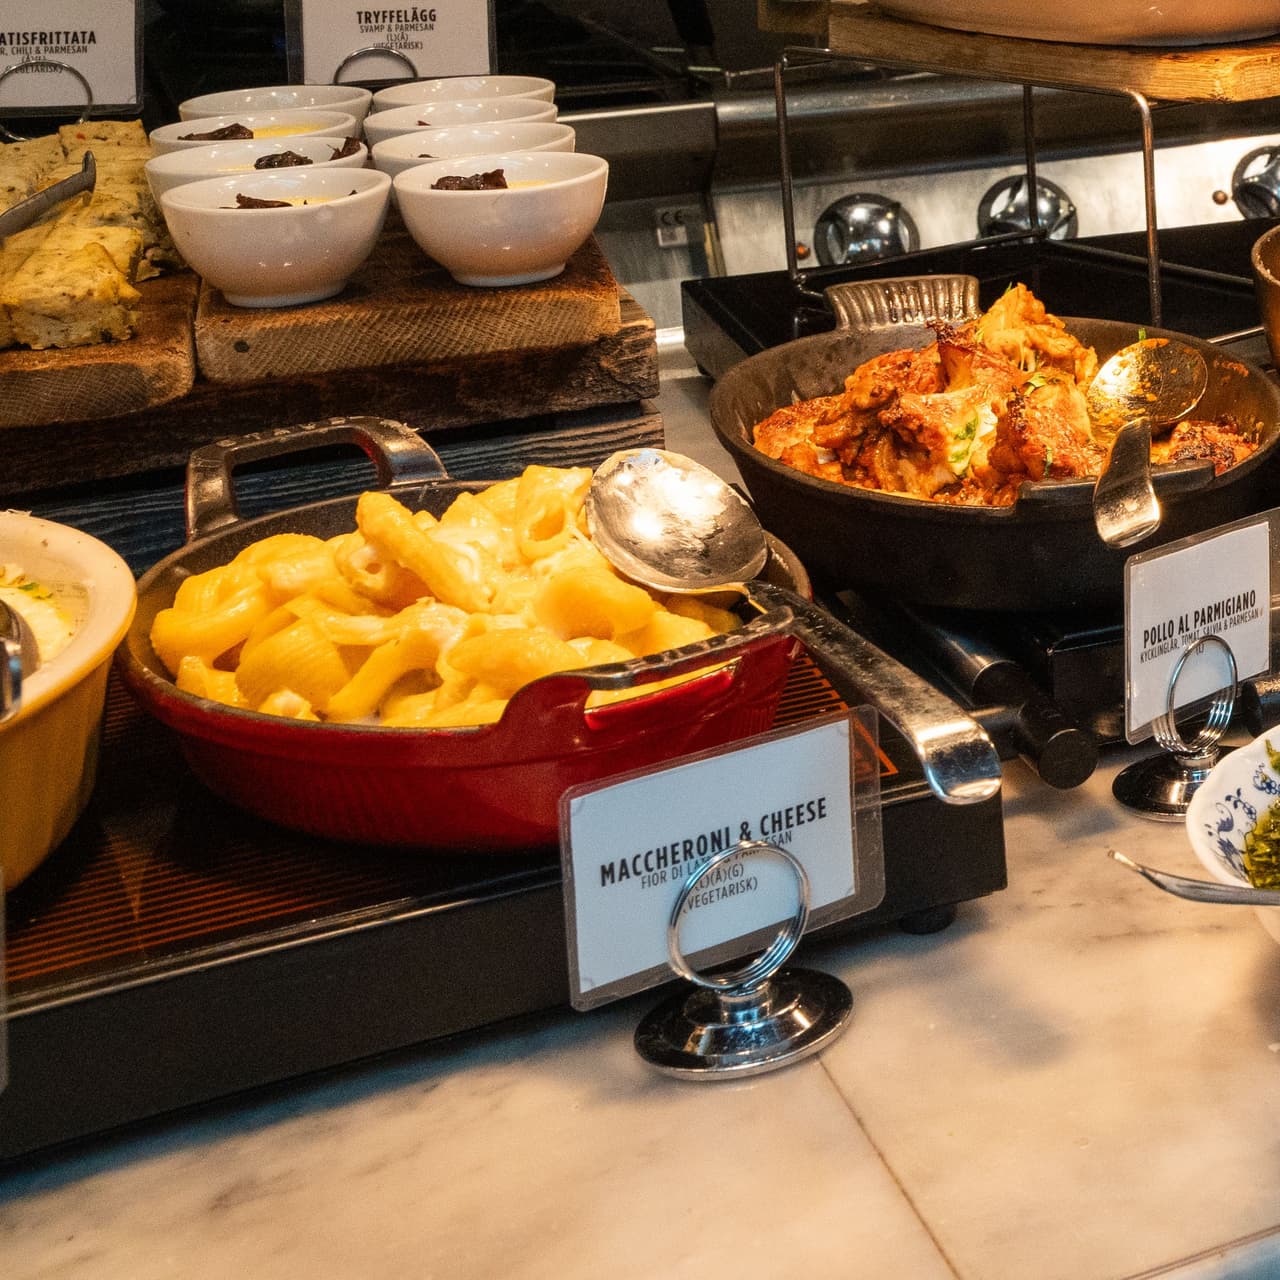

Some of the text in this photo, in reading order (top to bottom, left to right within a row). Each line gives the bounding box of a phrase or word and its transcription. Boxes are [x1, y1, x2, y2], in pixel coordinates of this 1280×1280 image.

[356, 7, 437, 24] TRYFFELÄGG
[360, 23, 434, 33] SVAMP & PARMESAN
[0, 31, 97, 46] ATISFRITTATA
[11, 46, 32, 55] CHILI
[35, 46, 41, 54] &
[44, 45, 88, 54] PARMESAN
[1143, 589, 1256, 648] POLLO AL PARMIGIANO
[1203, 621, 1222, 636] SALVIA
[1223, 621, 1228, 630] &
[1229, 608, 1259, 629] PARMESAN
[600, 797, 828, 887] MACCHERONI & CHEESE
[641, 870, 667, 889] FIOR
[671, 866, 683, 881] DI
